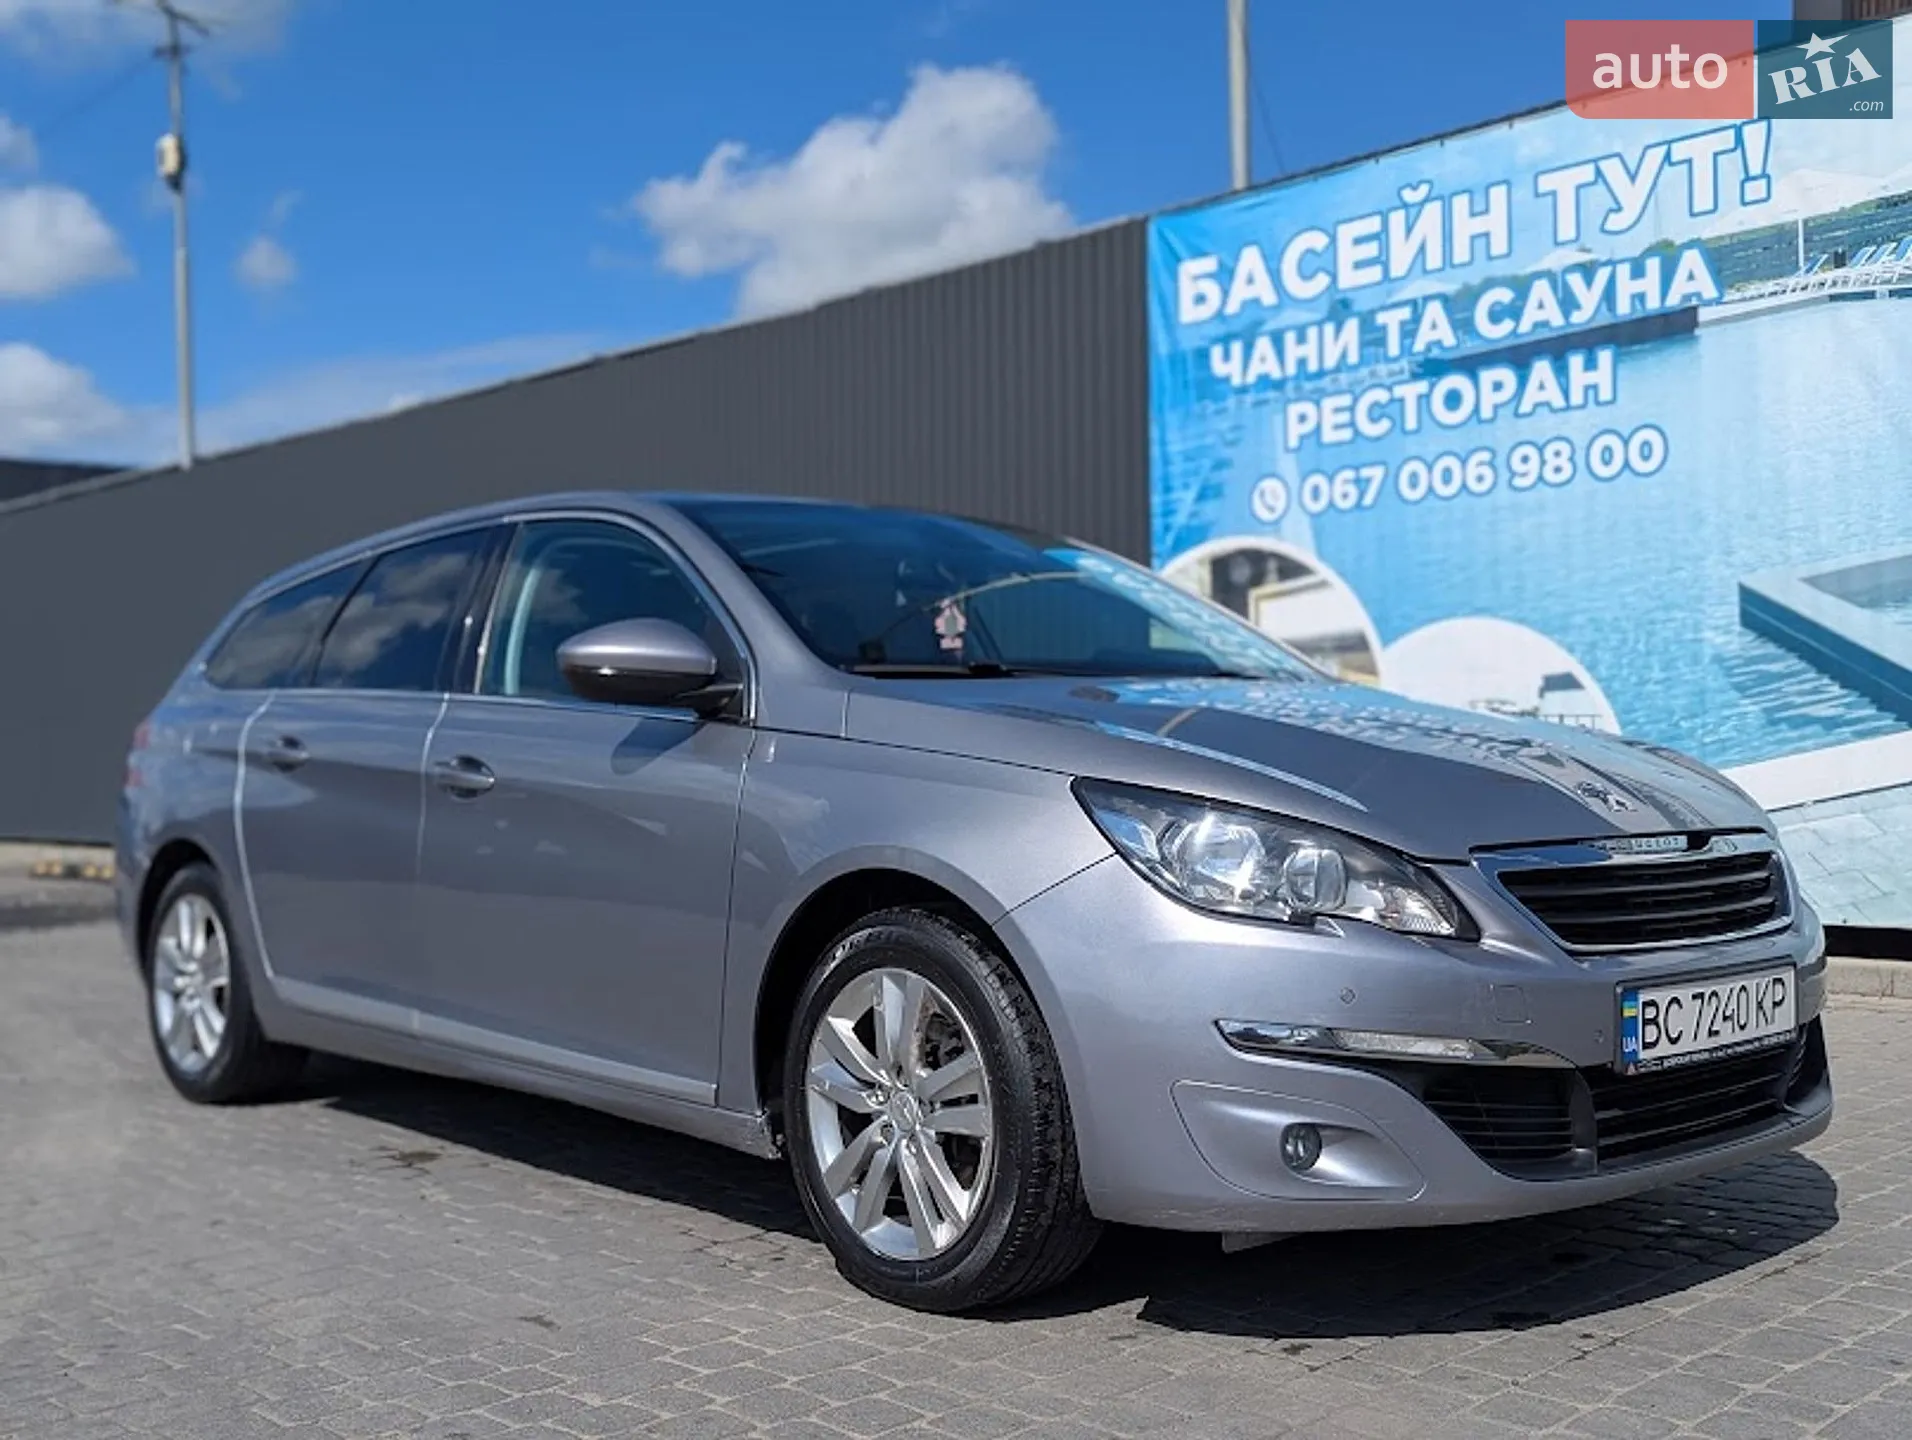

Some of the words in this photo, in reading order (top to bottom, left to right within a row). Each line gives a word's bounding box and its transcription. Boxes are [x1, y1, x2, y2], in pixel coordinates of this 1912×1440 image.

[1177, 181, 1510, 325] БАСЕЙН
[1535, 119, 1771, 245] ТУТ!
[1209, 316, 1361, 388] ЧАНИ
[1375, 298, 1458, 358] ТА
[1473, 249, 1720, 340] САУНА
[1286, 349, 1616, 450] РЕСТОРАН
[1301, 463, 1386, 515] 067
[1398, 449, 1497, 501] 006
[1508, 437, 1575, 491] 98
[1587, 425, 1668, 481] 00
[1622, 1037, 1638, 1052] UA
[1641, 995, 1683, 1050] BC
[1691, 984, 1749, 1041] 7240
[1756, 977, 1786, 1030] KP
